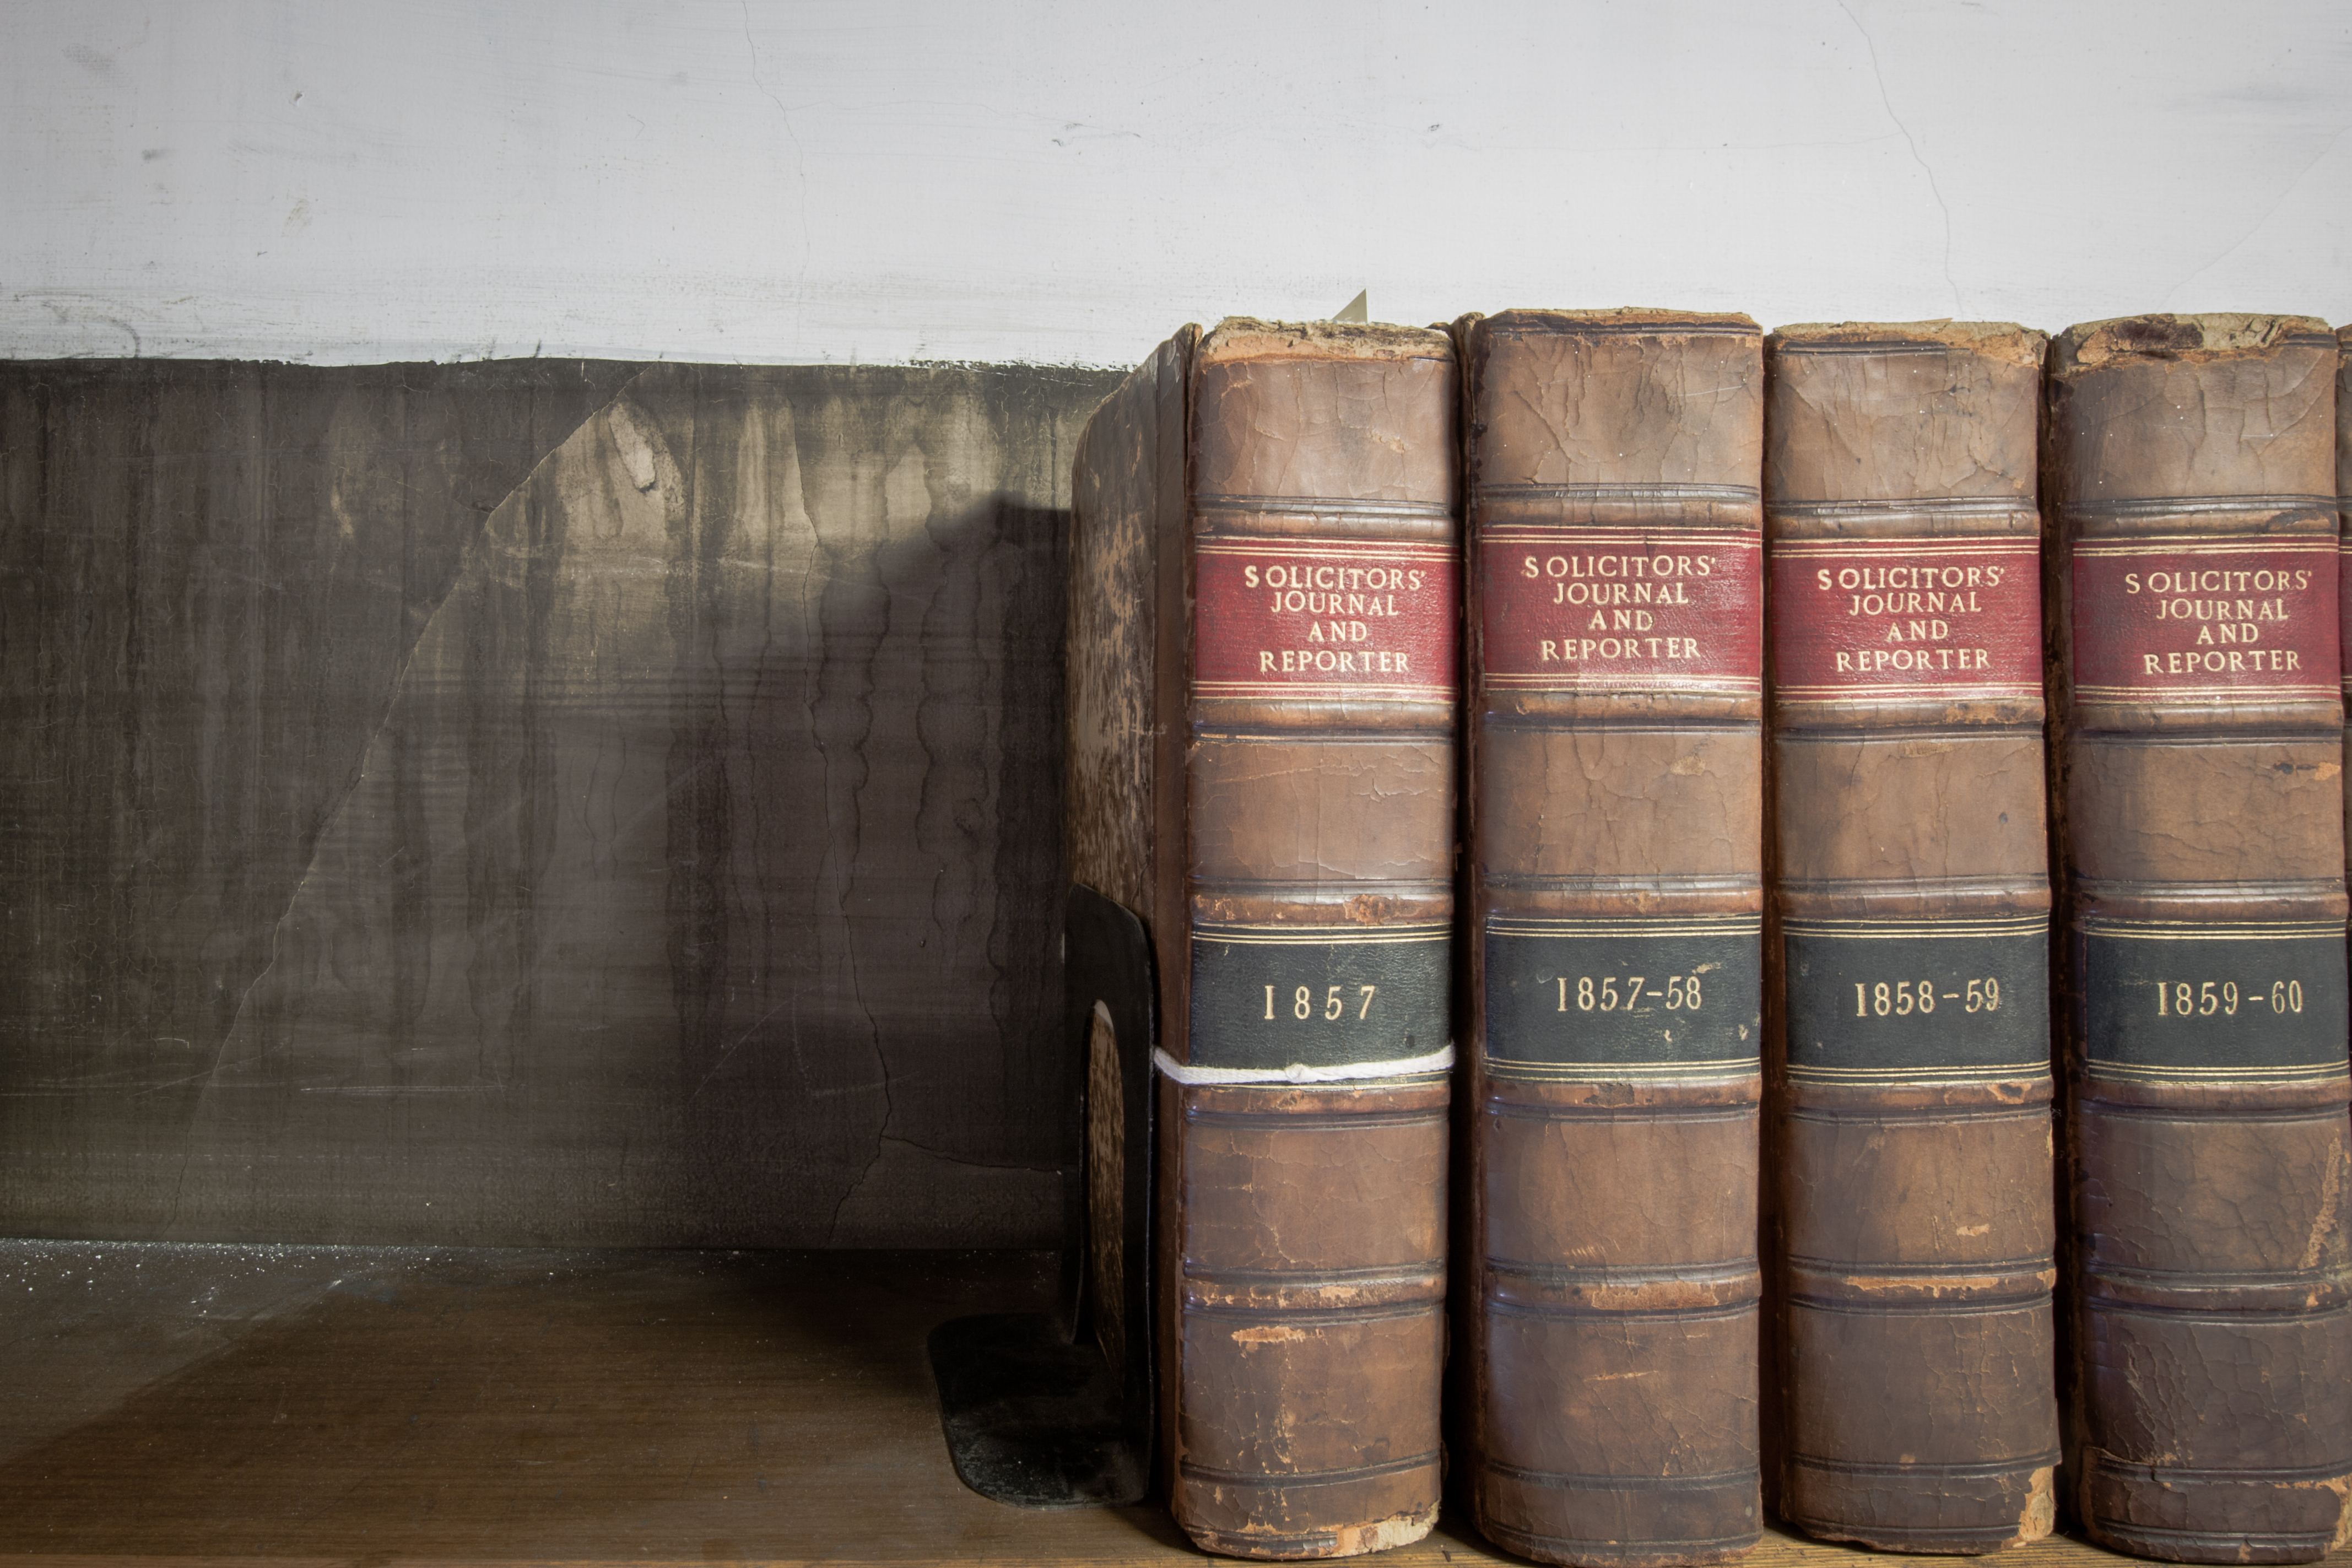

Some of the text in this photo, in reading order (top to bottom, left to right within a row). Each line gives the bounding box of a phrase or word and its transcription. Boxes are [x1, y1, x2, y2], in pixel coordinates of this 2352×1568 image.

[1245, 565, 1426, 590] SOLICITORS'
[1524, 555, 1716, 578] SOLICITORS'
[1817, 566, 2004, 591] SOLICITORS'
[1554, 582, 1689, 605] JOURNAL
[2125, 570, 2312, 594] SOLICITORS'
[1270, 590, 1399, 616] JOURNAL
[1850, 592, 1982, 615] JOURNAL
[2156, 599, 2289, 621] JOURNAL
[1308, 621, 1368, 642] AND
[1588, 609, 1653, 631] AND
[1886, 619, 1948, 641] AND
[2197, 624, 2258, 645] AND
[1542, 637, 1701, 661] REPORTER
[1836, 648, 1990, 672] REPORTER
[1259, 650, 1409, 673] REPORTER
[2144, 651, 2301, 675] REPORTER
[1264, 985, 1376, 1020] 1857
[1557, 976, 1703, 1012] 1857-58
[1855, 977, 2000, 1017] 1858-59
[2158, 980, 2304, 1016] 1859-60
